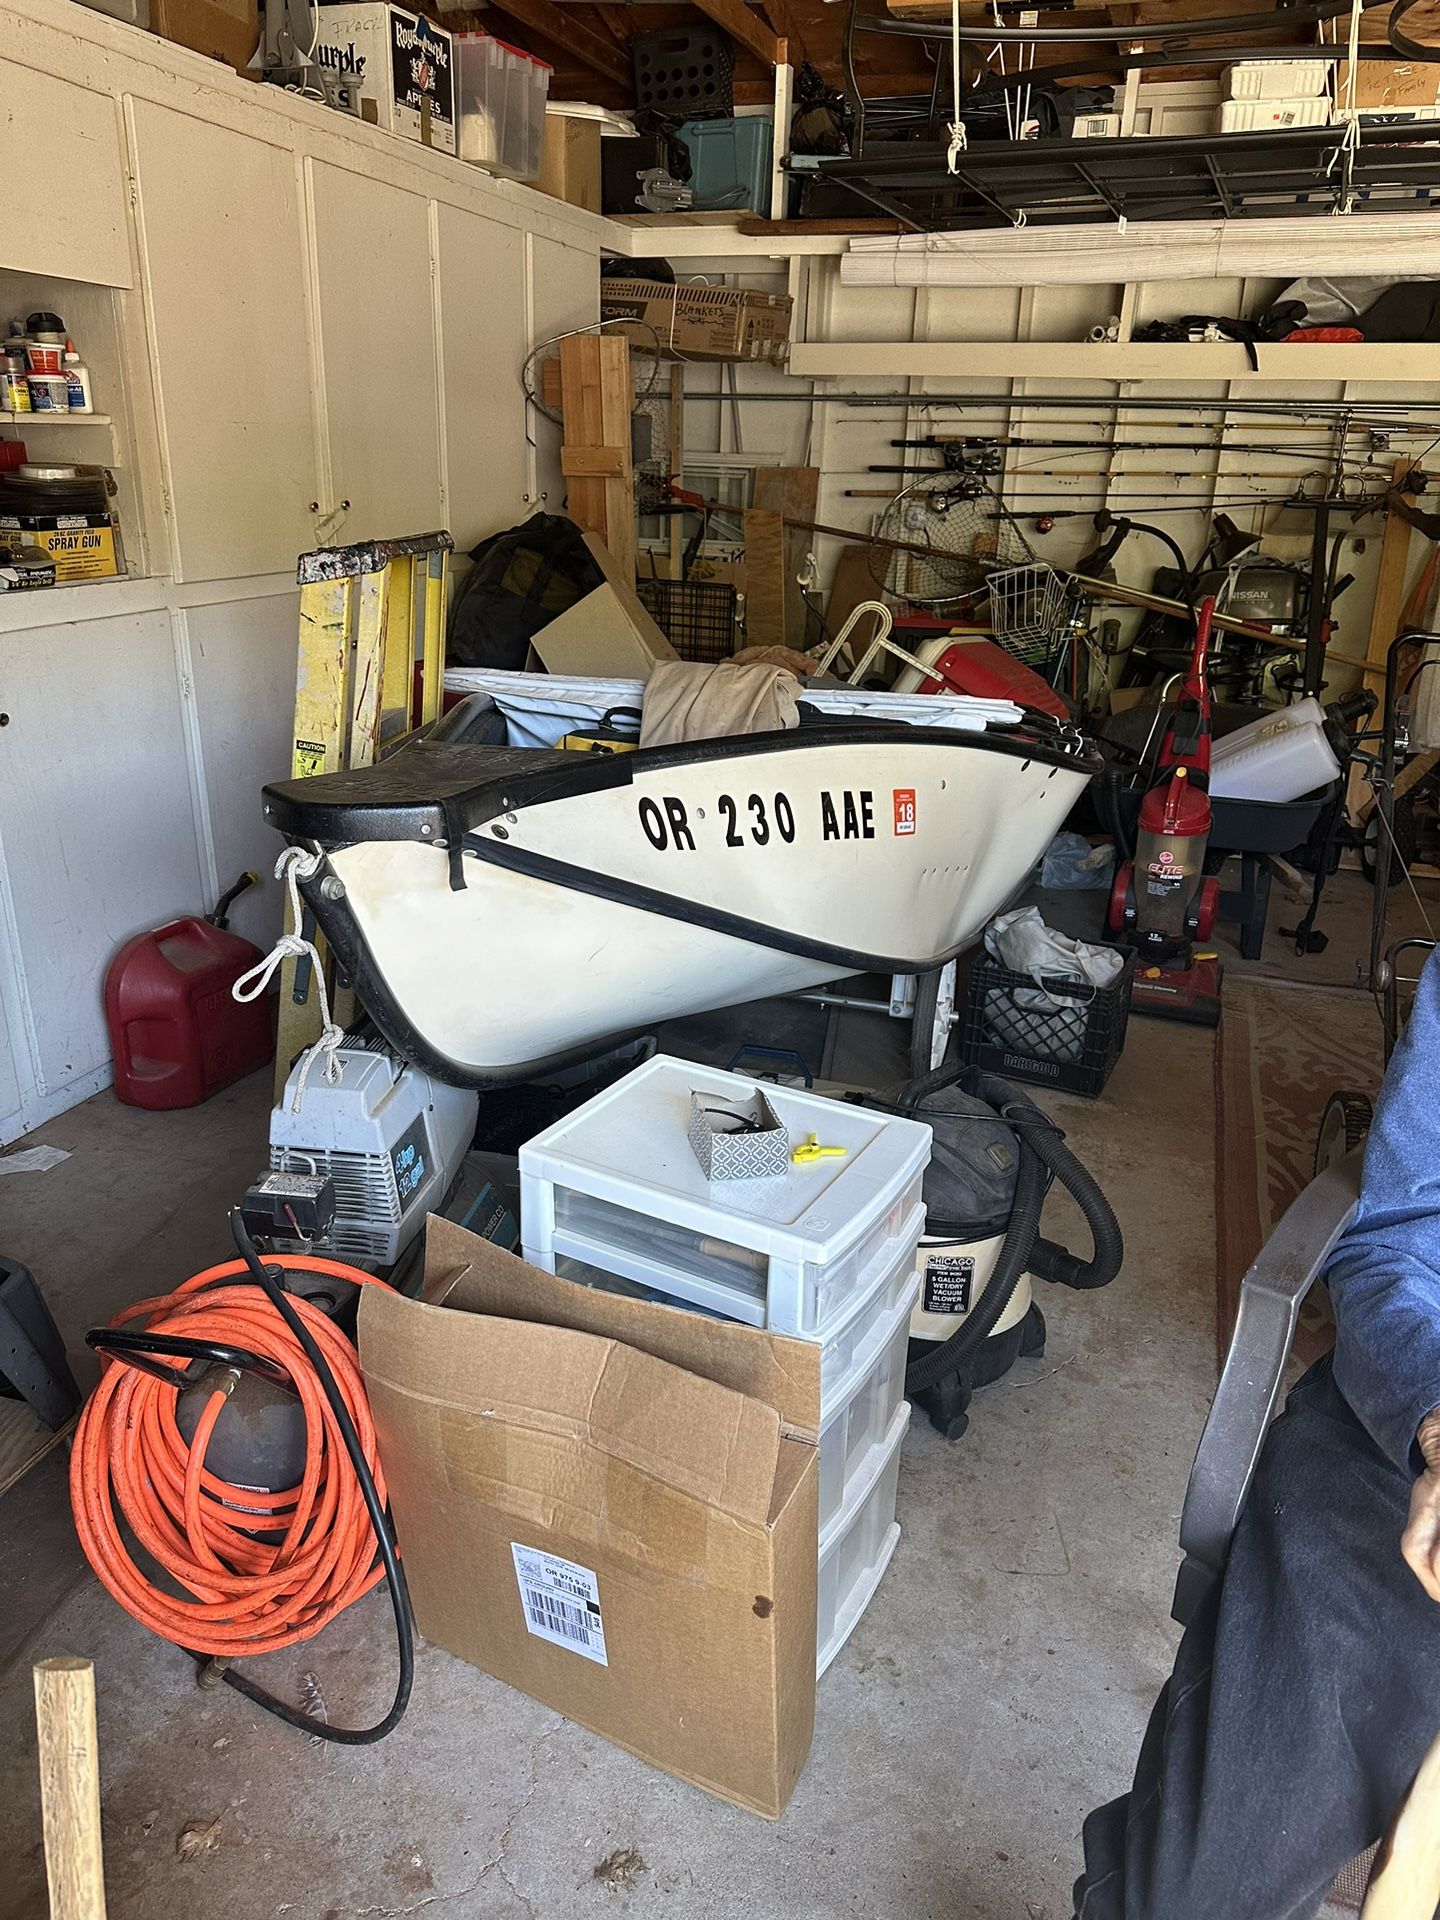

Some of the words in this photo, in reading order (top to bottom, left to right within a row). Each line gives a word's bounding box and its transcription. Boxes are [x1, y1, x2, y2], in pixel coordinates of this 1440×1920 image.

[318, 42, 367, 79] urple
[406, 89, 441, 114] APES
[675, 302, 726, 317] BLANKETS
[48, 535, 79, 551] SPRAY
[82, 534, 101, 548] GUN
[1232, 591, 1269, 599] NISSAN
[298, 741, 325, 752] CAUTION
[638, 796, 697, 851] OR
[718, 792, 796, 848] 230
[820, 790, 875, 841] AAE
[899, 802, 914, 822] 18
[1003, 1053, 1060, 1077] DARIGOLD
[928, 1256, 973, 1265] CHICAGO
[545, 1567, 558, 1577] OR
